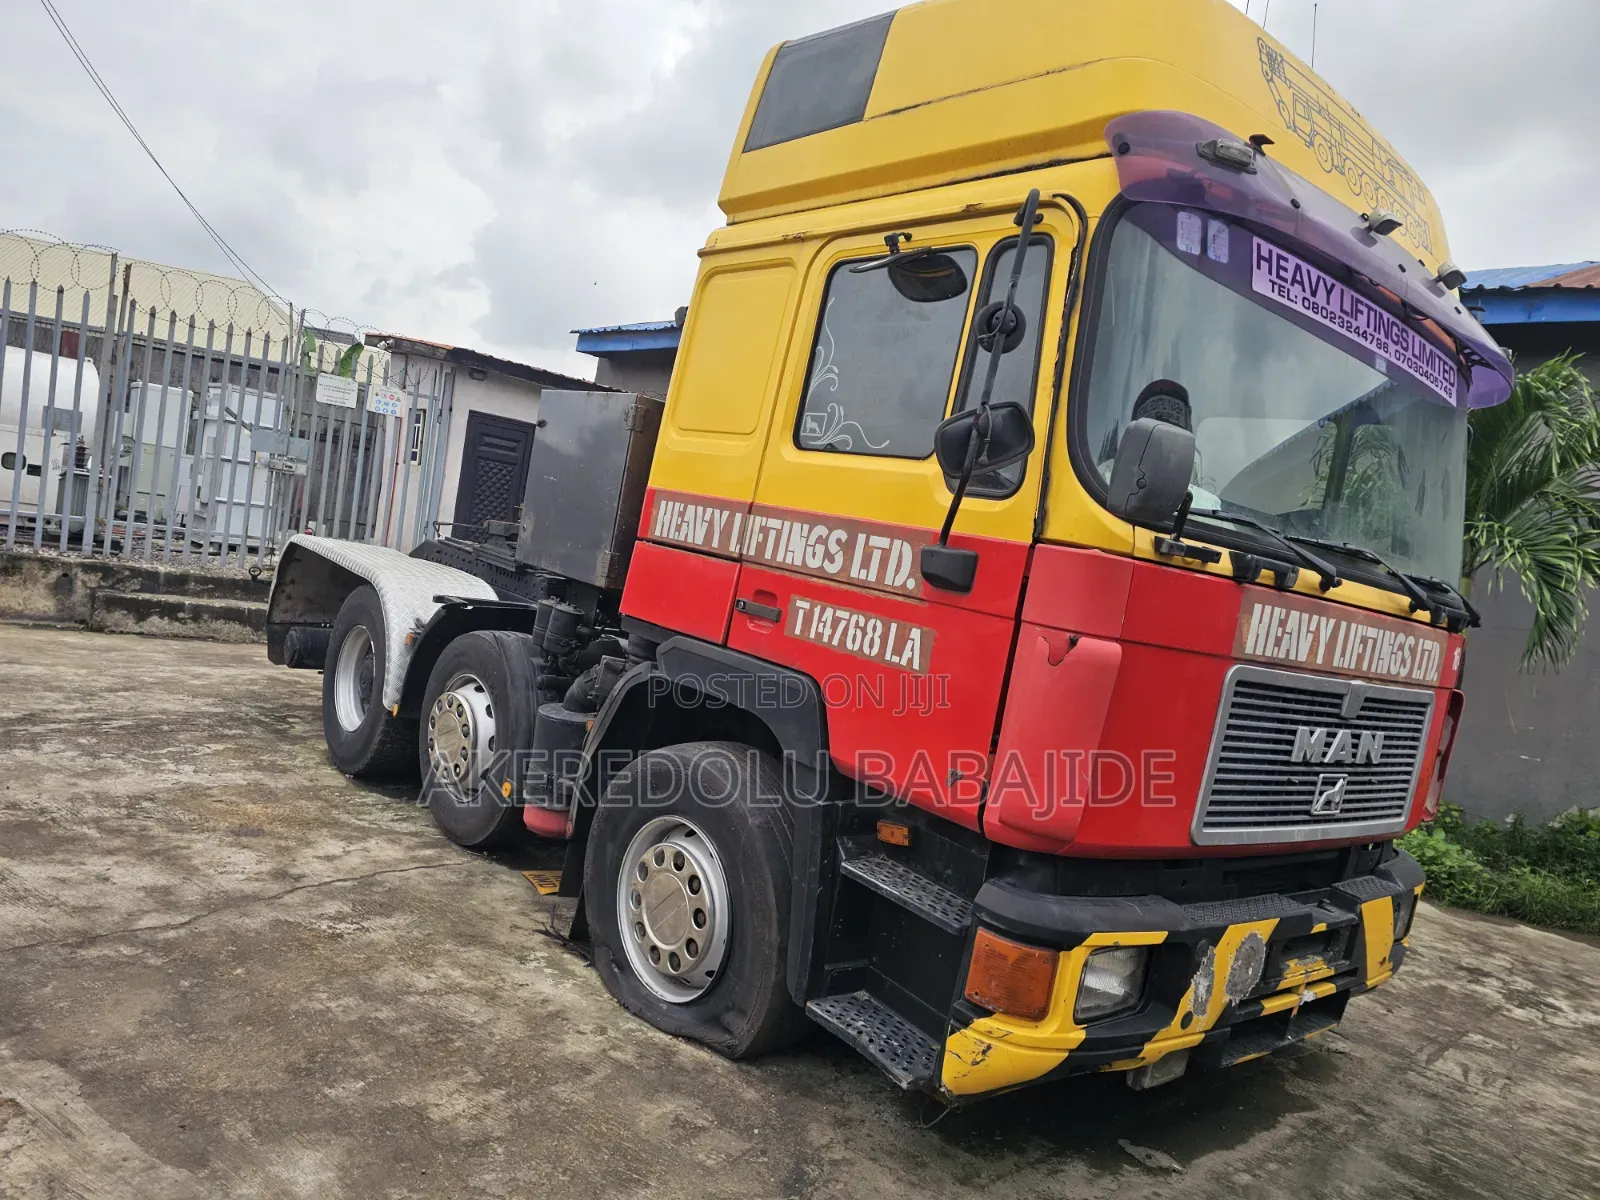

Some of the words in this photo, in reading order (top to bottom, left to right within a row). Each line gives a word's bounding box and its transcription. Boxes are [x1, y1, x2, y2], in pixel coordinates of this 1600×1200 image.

[1257, 242, 1336, 306] HEAVY
[1340, 288, 1409, 353] LIFTINGS
[1412, 334, 1456, 388] LIMITED
[1269, 278, 1298, 305] TEL:
[654, 499, 730, 549] HEAVY
[730, 512, 848, 574] LIFTINGS
[850, 533, 917, 590] LTD.
[884, 622, 922, 671] LA
[1245, 603, 1336, 665] HEAVY
[1332, 620, 1415, 679] LIFTINGS
[1290, 726, 1385, 765] MAN
